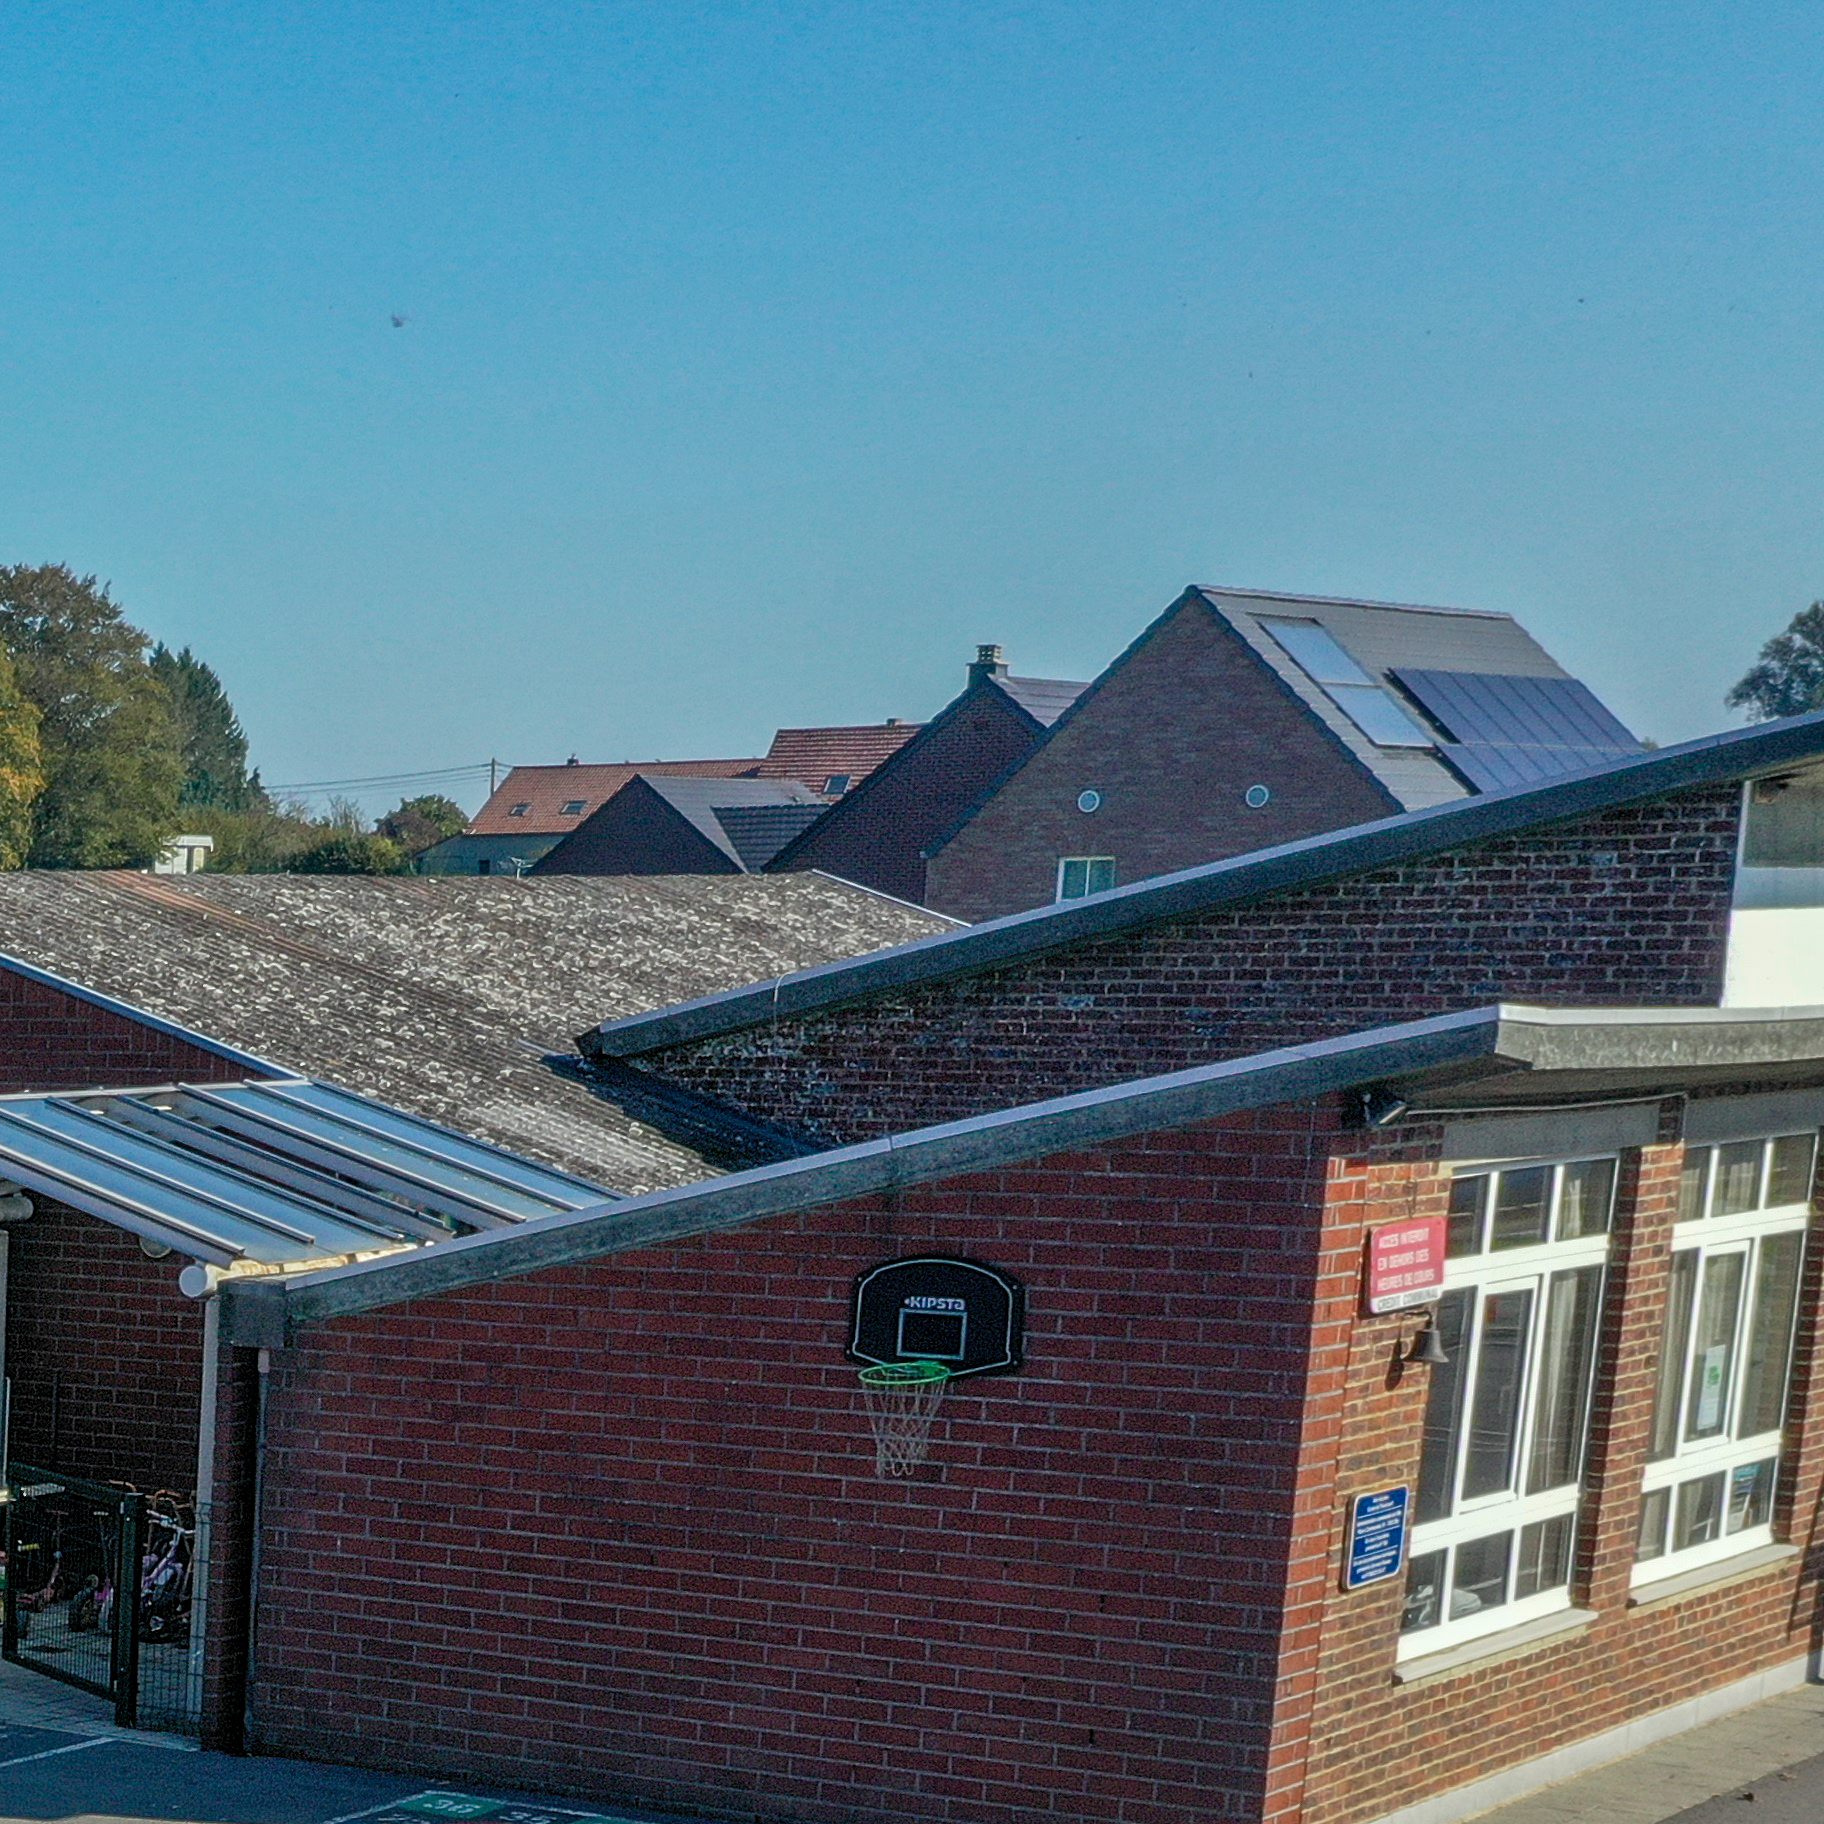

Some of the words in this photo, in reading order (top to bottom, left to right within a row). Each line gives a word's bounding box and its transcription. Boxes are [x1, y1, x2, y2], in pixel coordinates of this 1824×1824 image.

[1400, 1227, 1430, 1245] INTERDIT
[1377, 1256, 1388, 1271] EN
[1388, 1252, 1414, 1269] DEHORS
[1415, 1248, 1429, 1263] DES
[1376, 1274, 1403, 1291] HEURES
[1403, 1272, 1413, 1286] DE
[1413, 1268, 1435, 1284] COURS
[423, 1799, 480, 1813] 36
